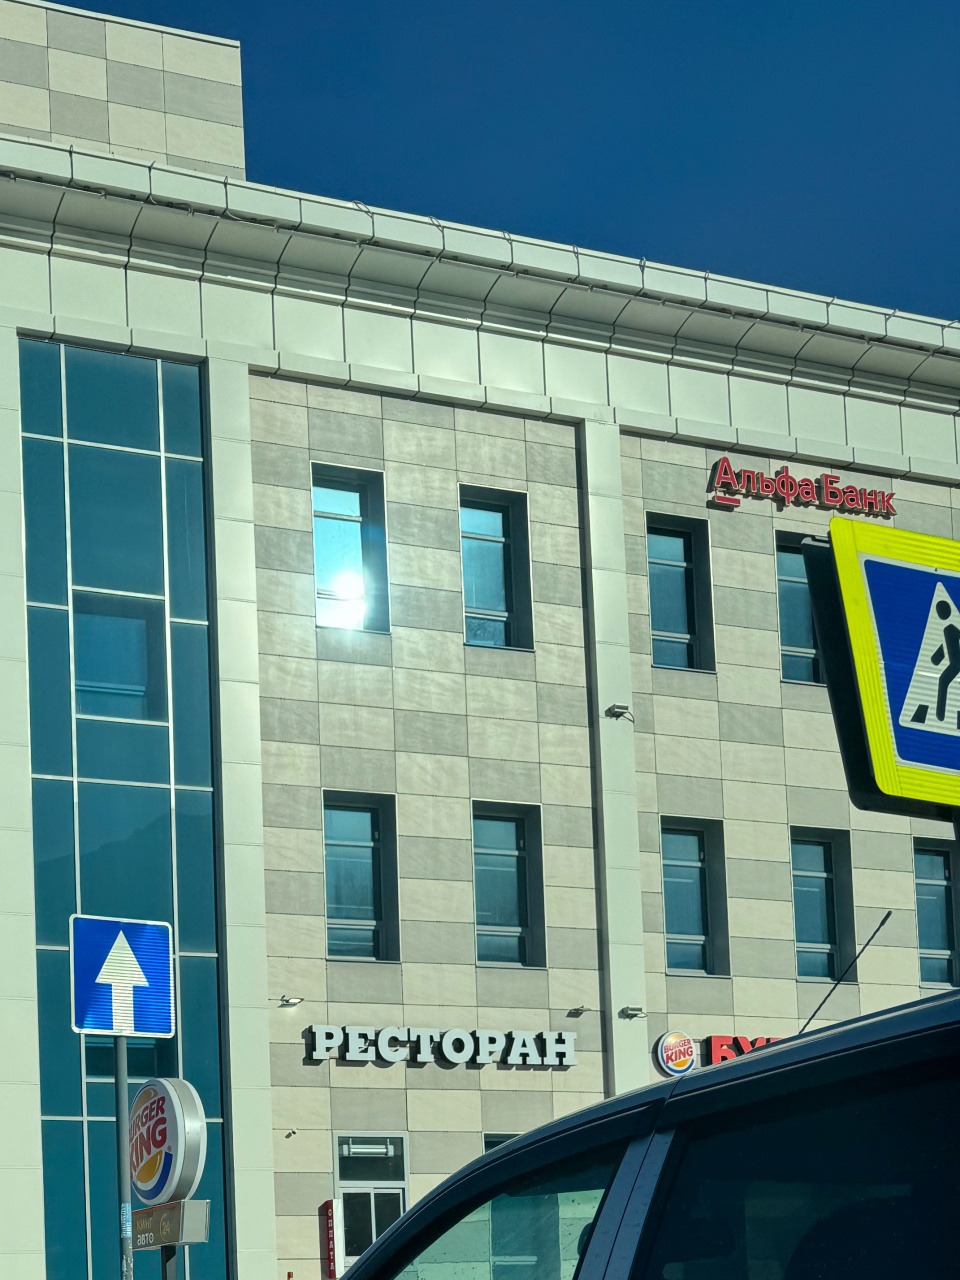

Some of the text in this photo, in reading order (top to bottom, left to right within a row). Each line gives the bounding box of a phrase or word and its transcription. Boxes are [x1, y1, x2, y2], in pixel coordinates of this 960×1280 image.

[311, 1024, 578, 1067] РЕСТОРАН
[664, 1039, 691, 1054] BURGER
[665, 1047, 693, 1066] KING
[130, 1096, 165, 1141] URGER
[130, 1117, 167, 1182] KING
[327, 1209, 335, 1270] ОПЛАТА
